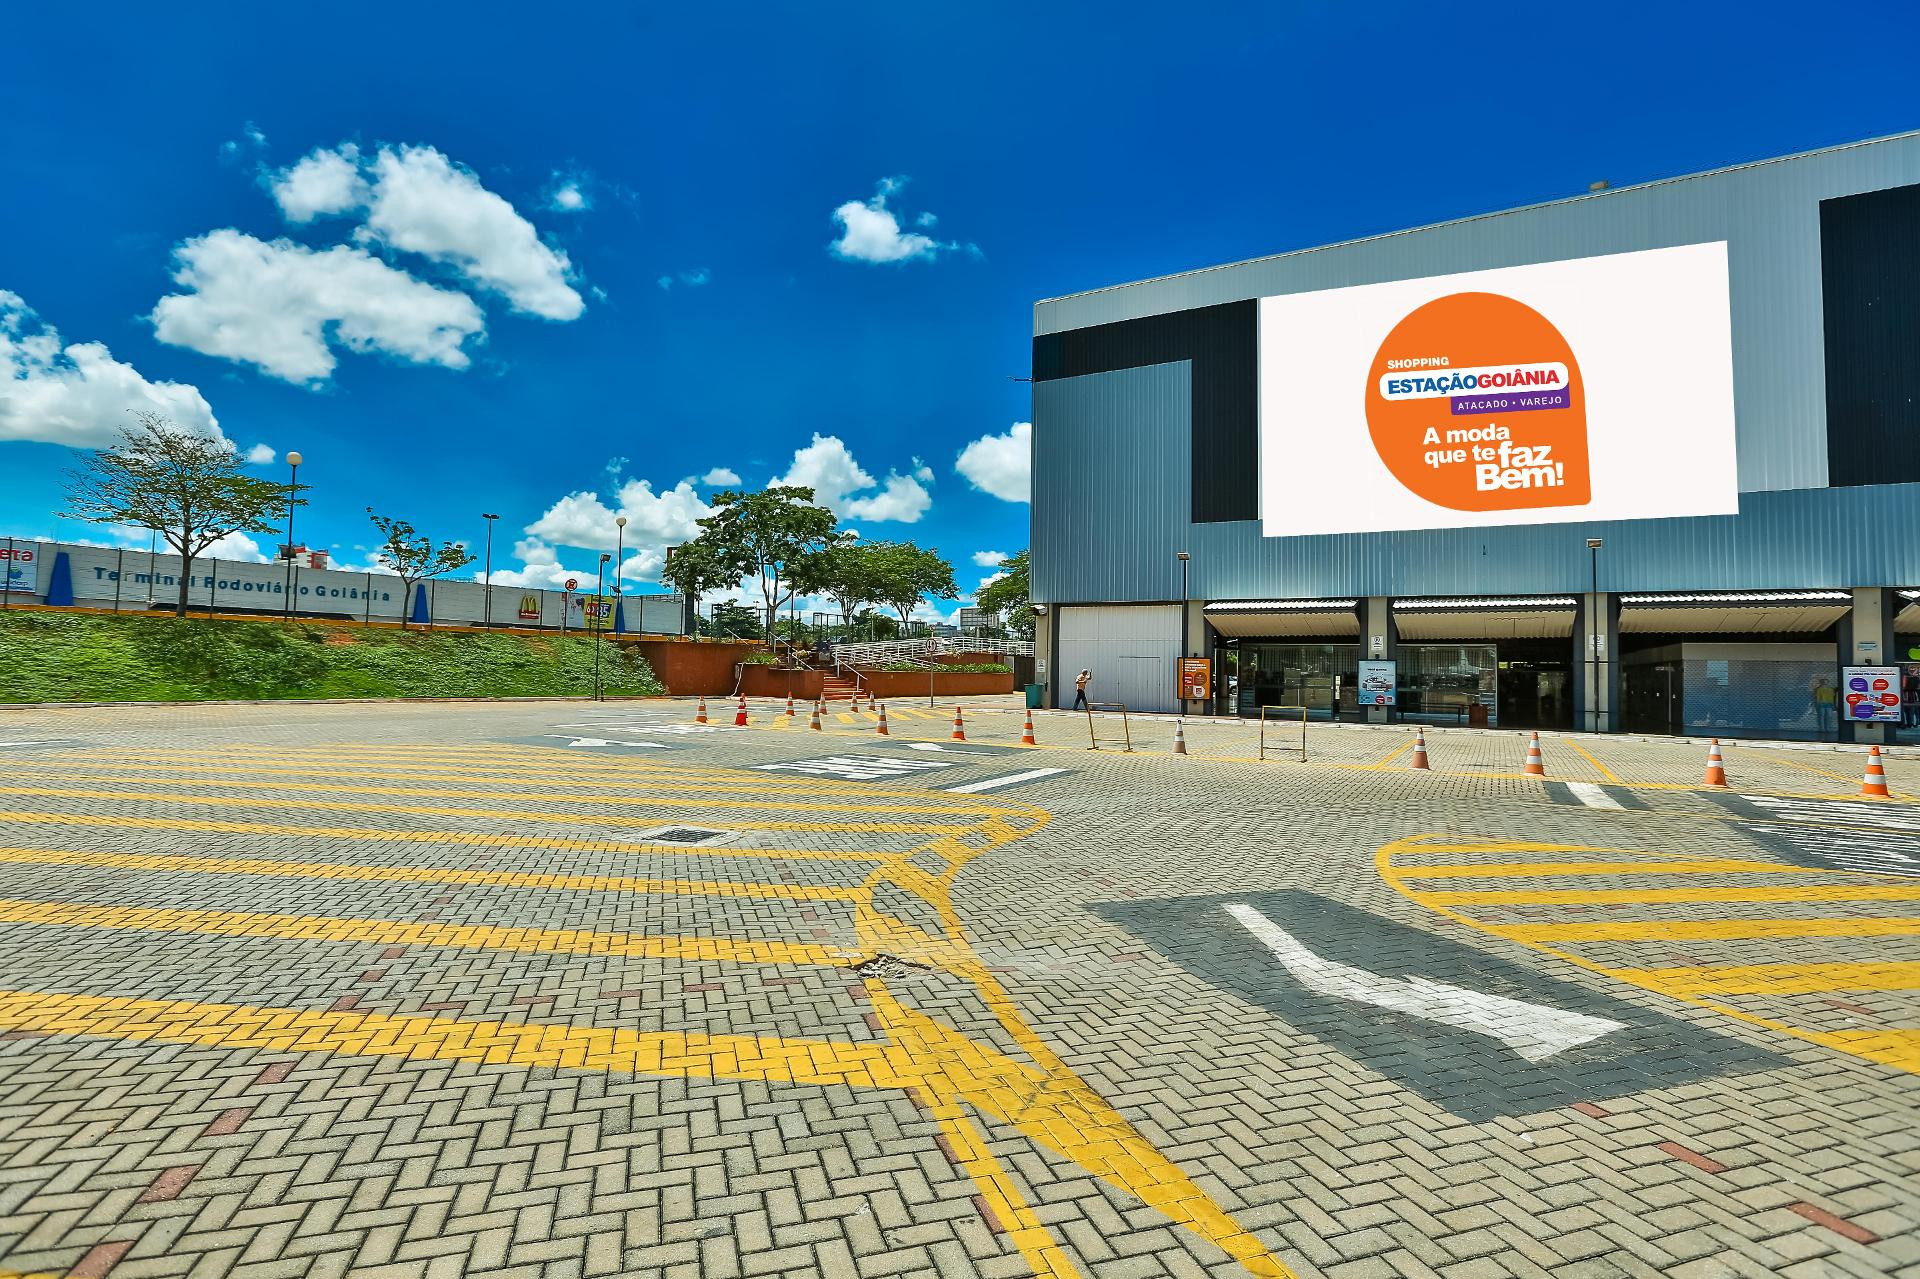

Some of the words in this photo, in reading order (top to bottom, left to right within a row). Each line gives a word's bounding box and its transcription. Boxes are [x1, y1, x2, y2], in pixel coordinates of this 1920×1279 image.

[1387, 357, 1449, 369] SHOPPING
[1458, 399, 1508, 411] ATACADO
[1520, 396, 1562, 407] VAREJO
[1423, 427, 1441, 445] A
[1446, 423, 1510, 443] moda
[1424, 448, 1467, 468] que
[1471, 444, 1495, 461] te
[1498, 441, 1553, 469] faz
[1475, 462, 1565, 491] Bem!
[94, 567, 196, 587] Terminl
[204, 576, 309, 597] Rodoviário
[315, 586, 390, 601] Goiânia
